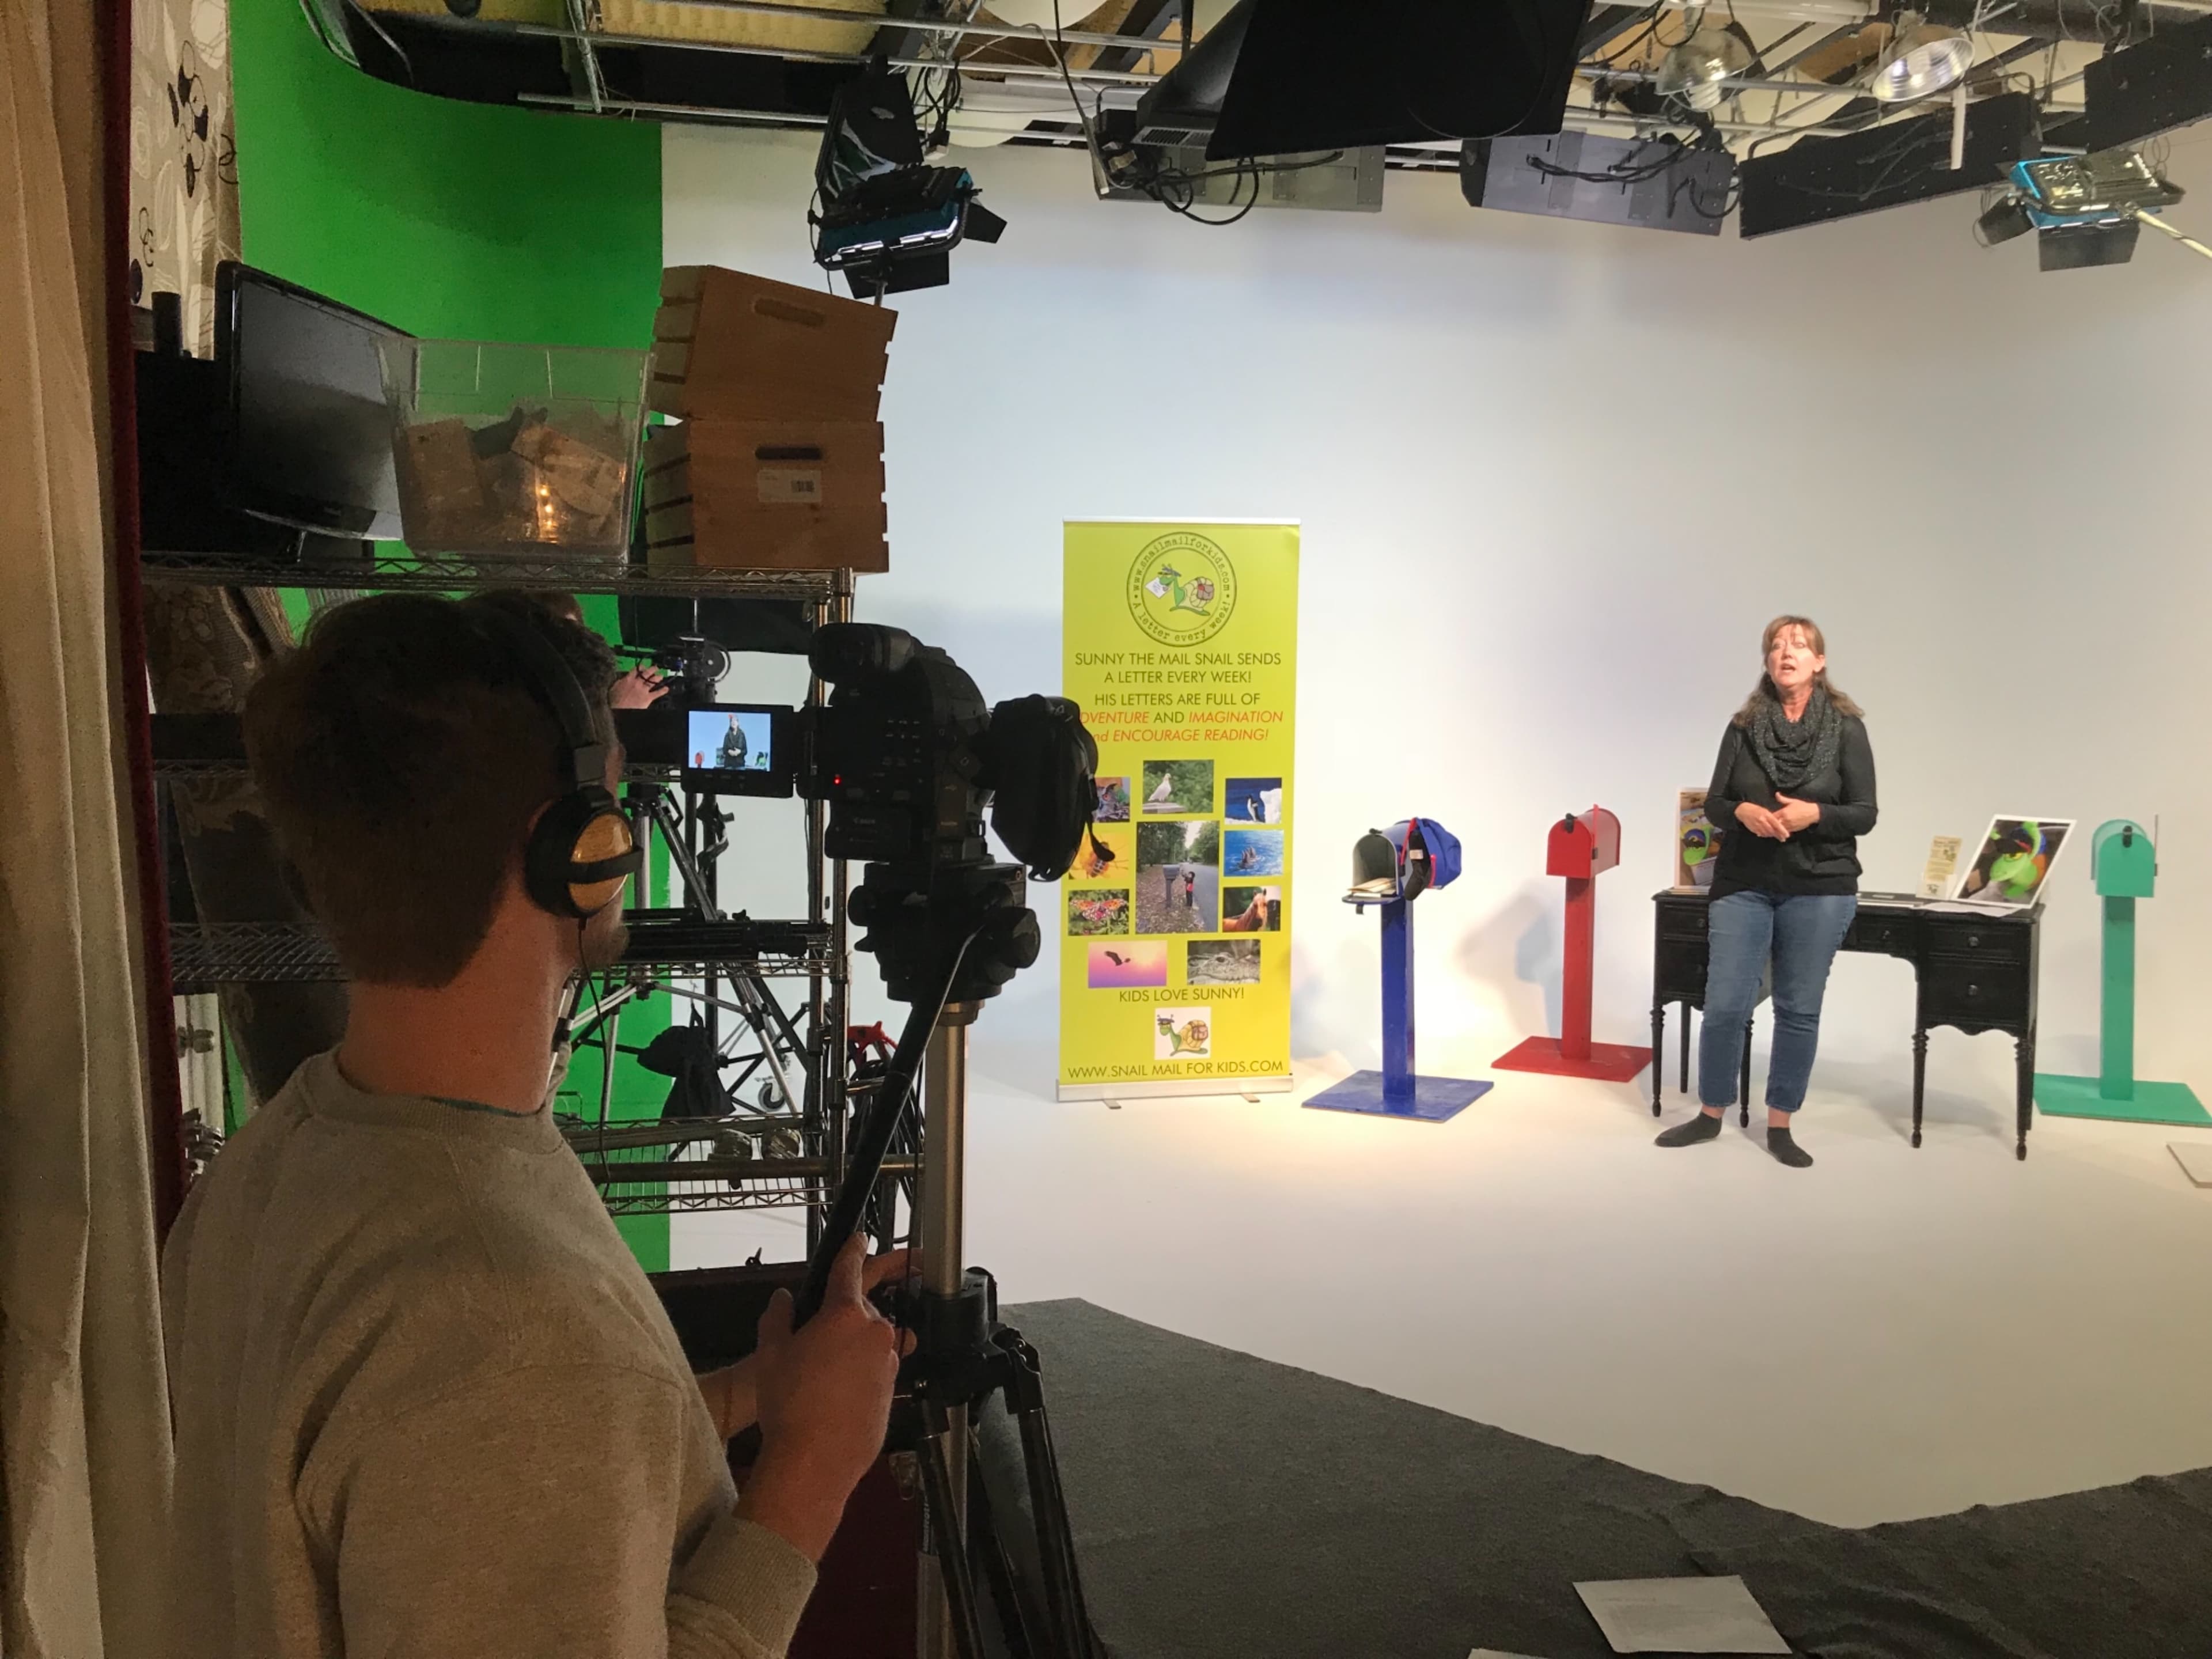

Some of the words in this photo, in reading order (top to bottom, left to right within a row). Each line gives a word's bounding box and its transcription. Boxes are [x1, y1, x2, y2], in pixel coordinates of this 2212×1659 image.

[1133, 536, 1230, 592] www.snailmailforkids.com
[1138, 611, 1171, 639] letter
[1175, 628, 1206, 642] every
[1209, 601, 1230, 630] week!
[1075, 652, 1124, 666] SUNNY
[1128, 652, 1154, 665] THE
[1159, 653, 1191, 665] MAIL
[1195, 652, 1233, 665] SNAIL
[1237, 652, 1282, 665] SENDS
[1104, 671, 1115, 684] A
[1118, 671, 1162, 684] LETTER
[1167, 671, 1207, 683] EVERY
[1210, 671, 1252, 684] WEEK!
[1094, 693, 1118, 706] HIS
[1121, 693, 1173, 706] LETTERS
[1176, 693, 1201, 706] ARE
[1206, 693, 1237, 706] FULL
[1240, 692, 1261, 706] OF
[1080, 711, 1150, 724] DVENTURE
[1153, 711, 1185, 724] AND
[1188, 710, 1283, 724] IMAGINATION
[1093, 729, 1109, 742] nd
[1113, 729, 1200, 743] ENCOURAGE
[1204, 728, 1269, 742] READING!
[1119, 988, 1150, 1002] KIDS
[1153, 988, 1189, 1002] LOVE
[1192, 987, 1245, 1001] SUNNY!
[1067, 1065, 1147, 1079] WWW.SNAIL
[1152, 1064, 1183, 1076] MAIL
[1187, 1062, 1213, 1075] FOR
[1217, 1060, 1284, 1073] KIDS.COM
